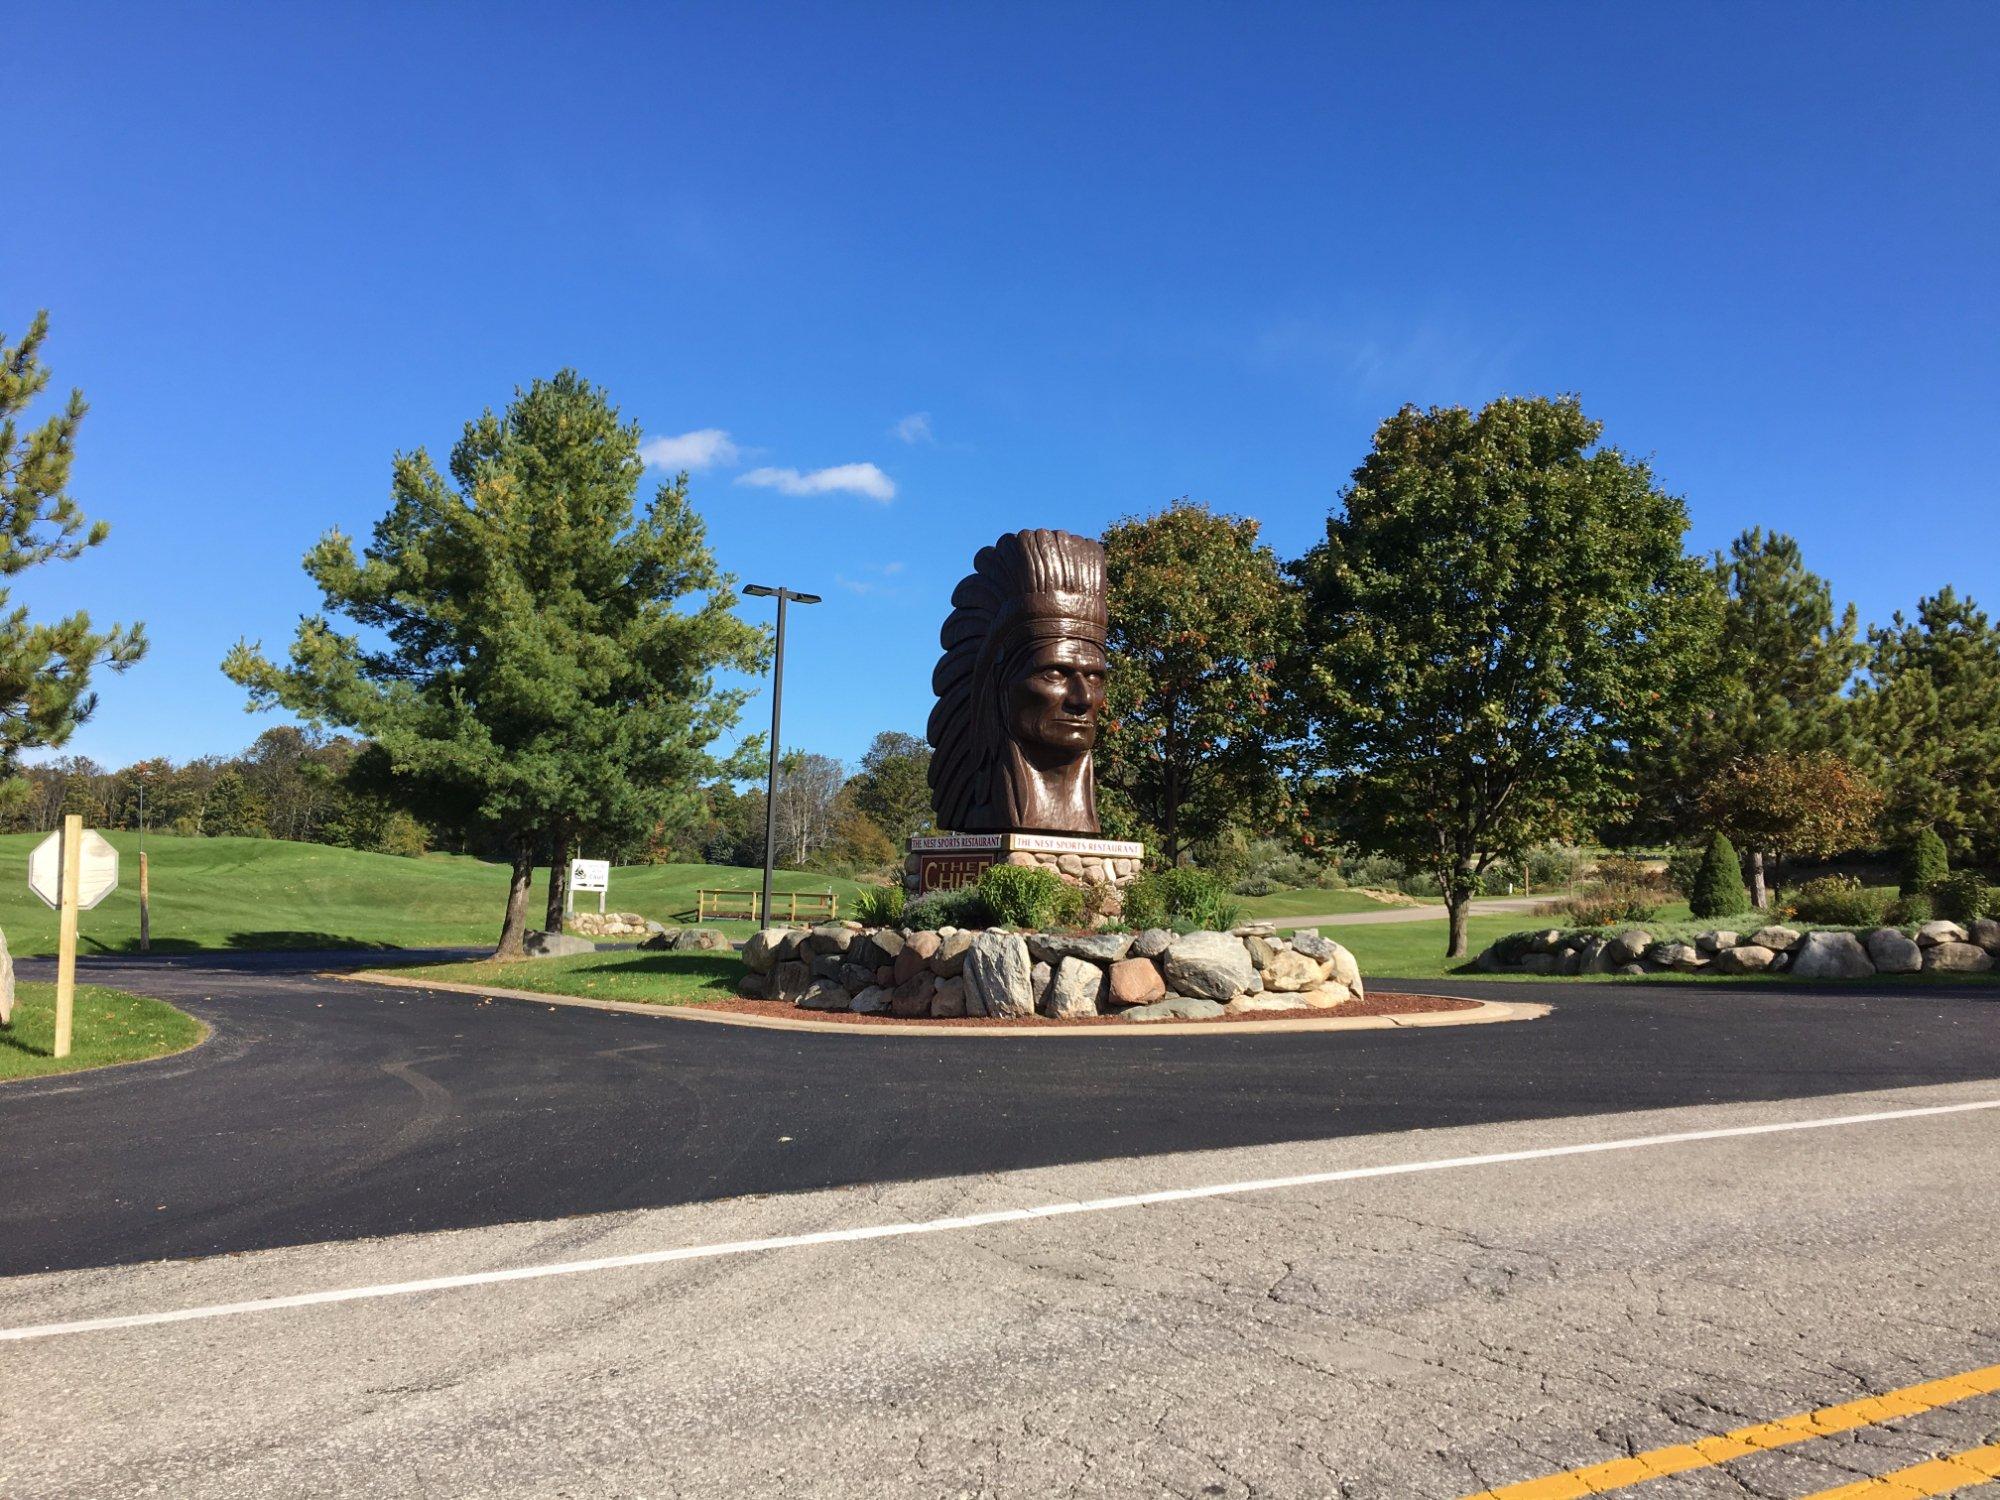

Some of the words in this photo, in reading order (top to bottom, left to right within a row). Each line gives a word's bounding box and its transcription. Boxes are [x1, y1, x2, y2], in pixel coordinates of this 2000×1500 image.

[912, 838, 922, 848] THE
[924, 838, 937, 848] NEST
[938, 837, 960, 848] SPORTS
[961, 835, 1000, 848] RESTAURANT
[1018, 837, 1031, 847] THE
[1034, 839, 1053, 848] NEST
[1056, 841, 1086, 851] SPORTS
[1088, 842, 1138, 853] RESTAURANT
[938, 861, 977, 872] THE
